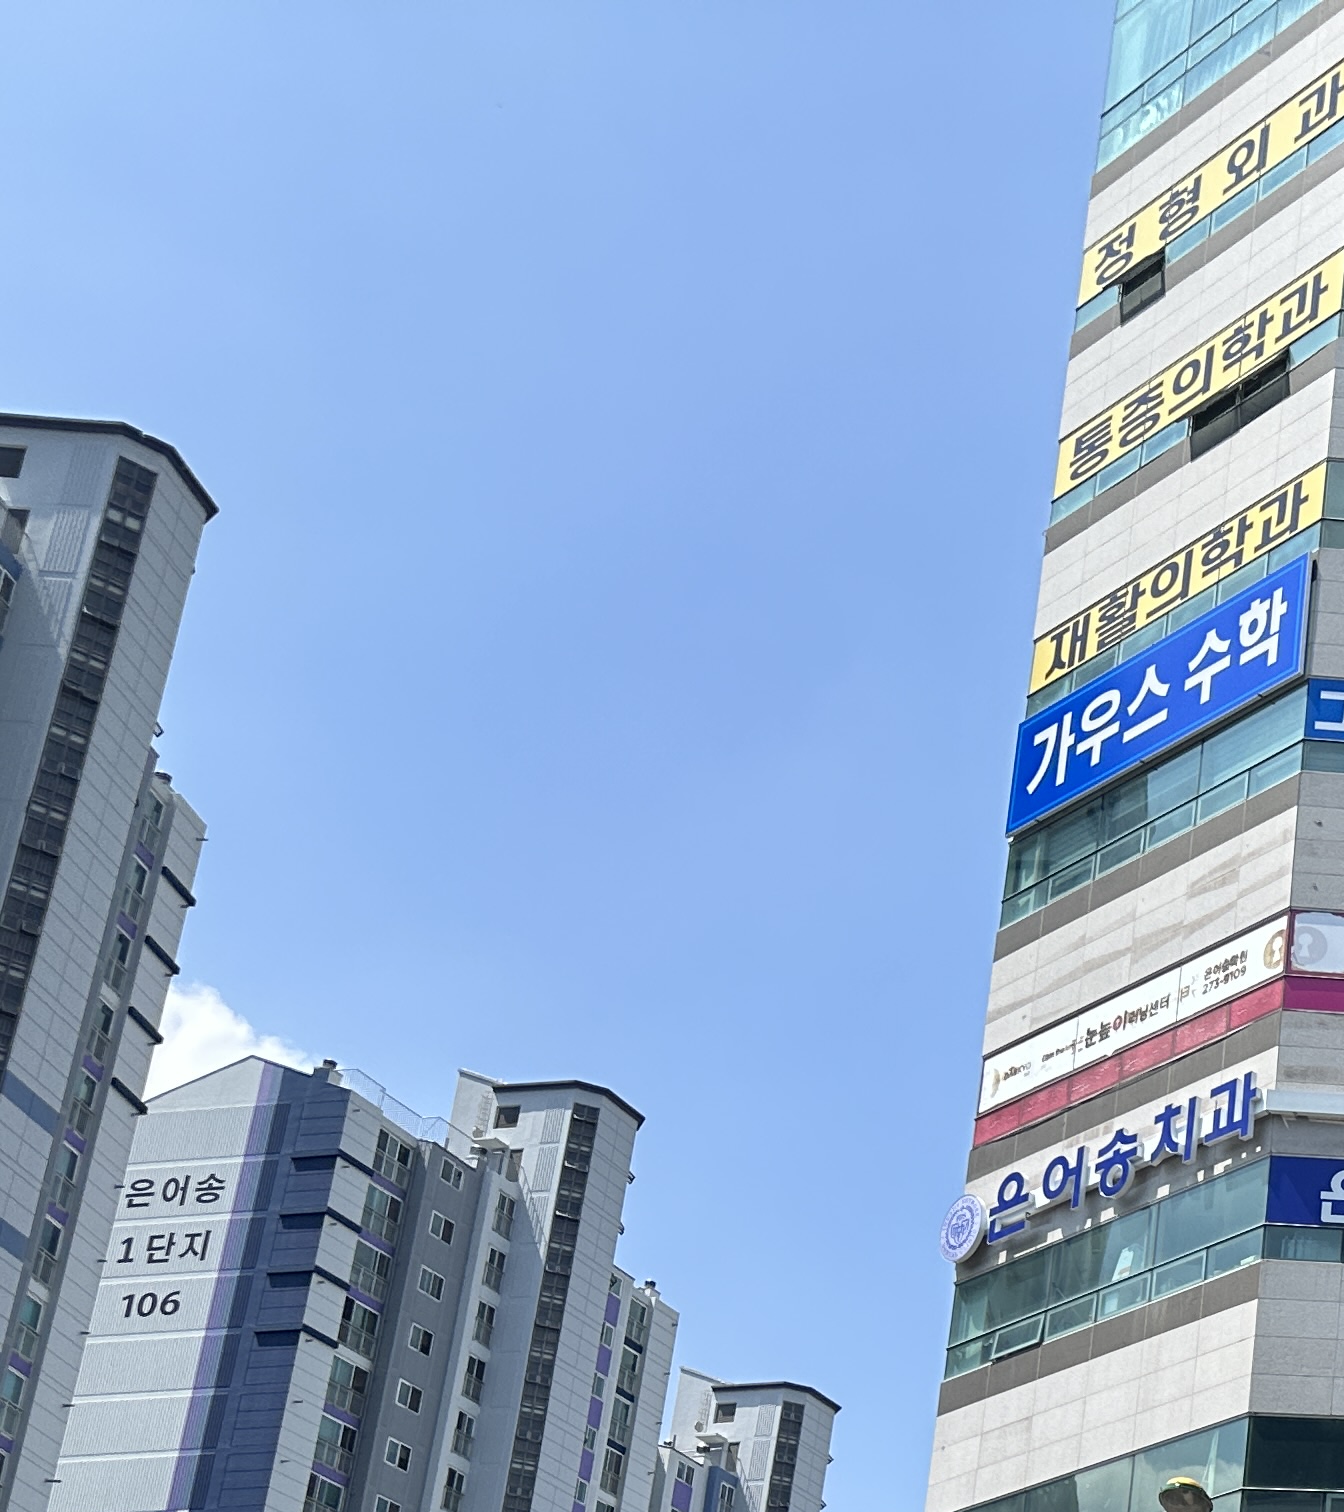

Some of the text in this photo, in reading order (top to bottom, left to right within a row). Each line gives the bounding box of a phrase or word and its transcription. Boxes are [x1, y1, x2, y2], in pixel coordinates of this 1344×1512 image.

[1068, 271, 1329, 482] 통증의학과
[1045, 478, 1310, 681] 재활의학과
[1026, 586, 1289, 795] 가우스 수학
[125, 1173, 226, 1209] 은어송
[987, 1071, 1258, 1245] 은어송치과
[122, 1290, 181, 1318] 106
